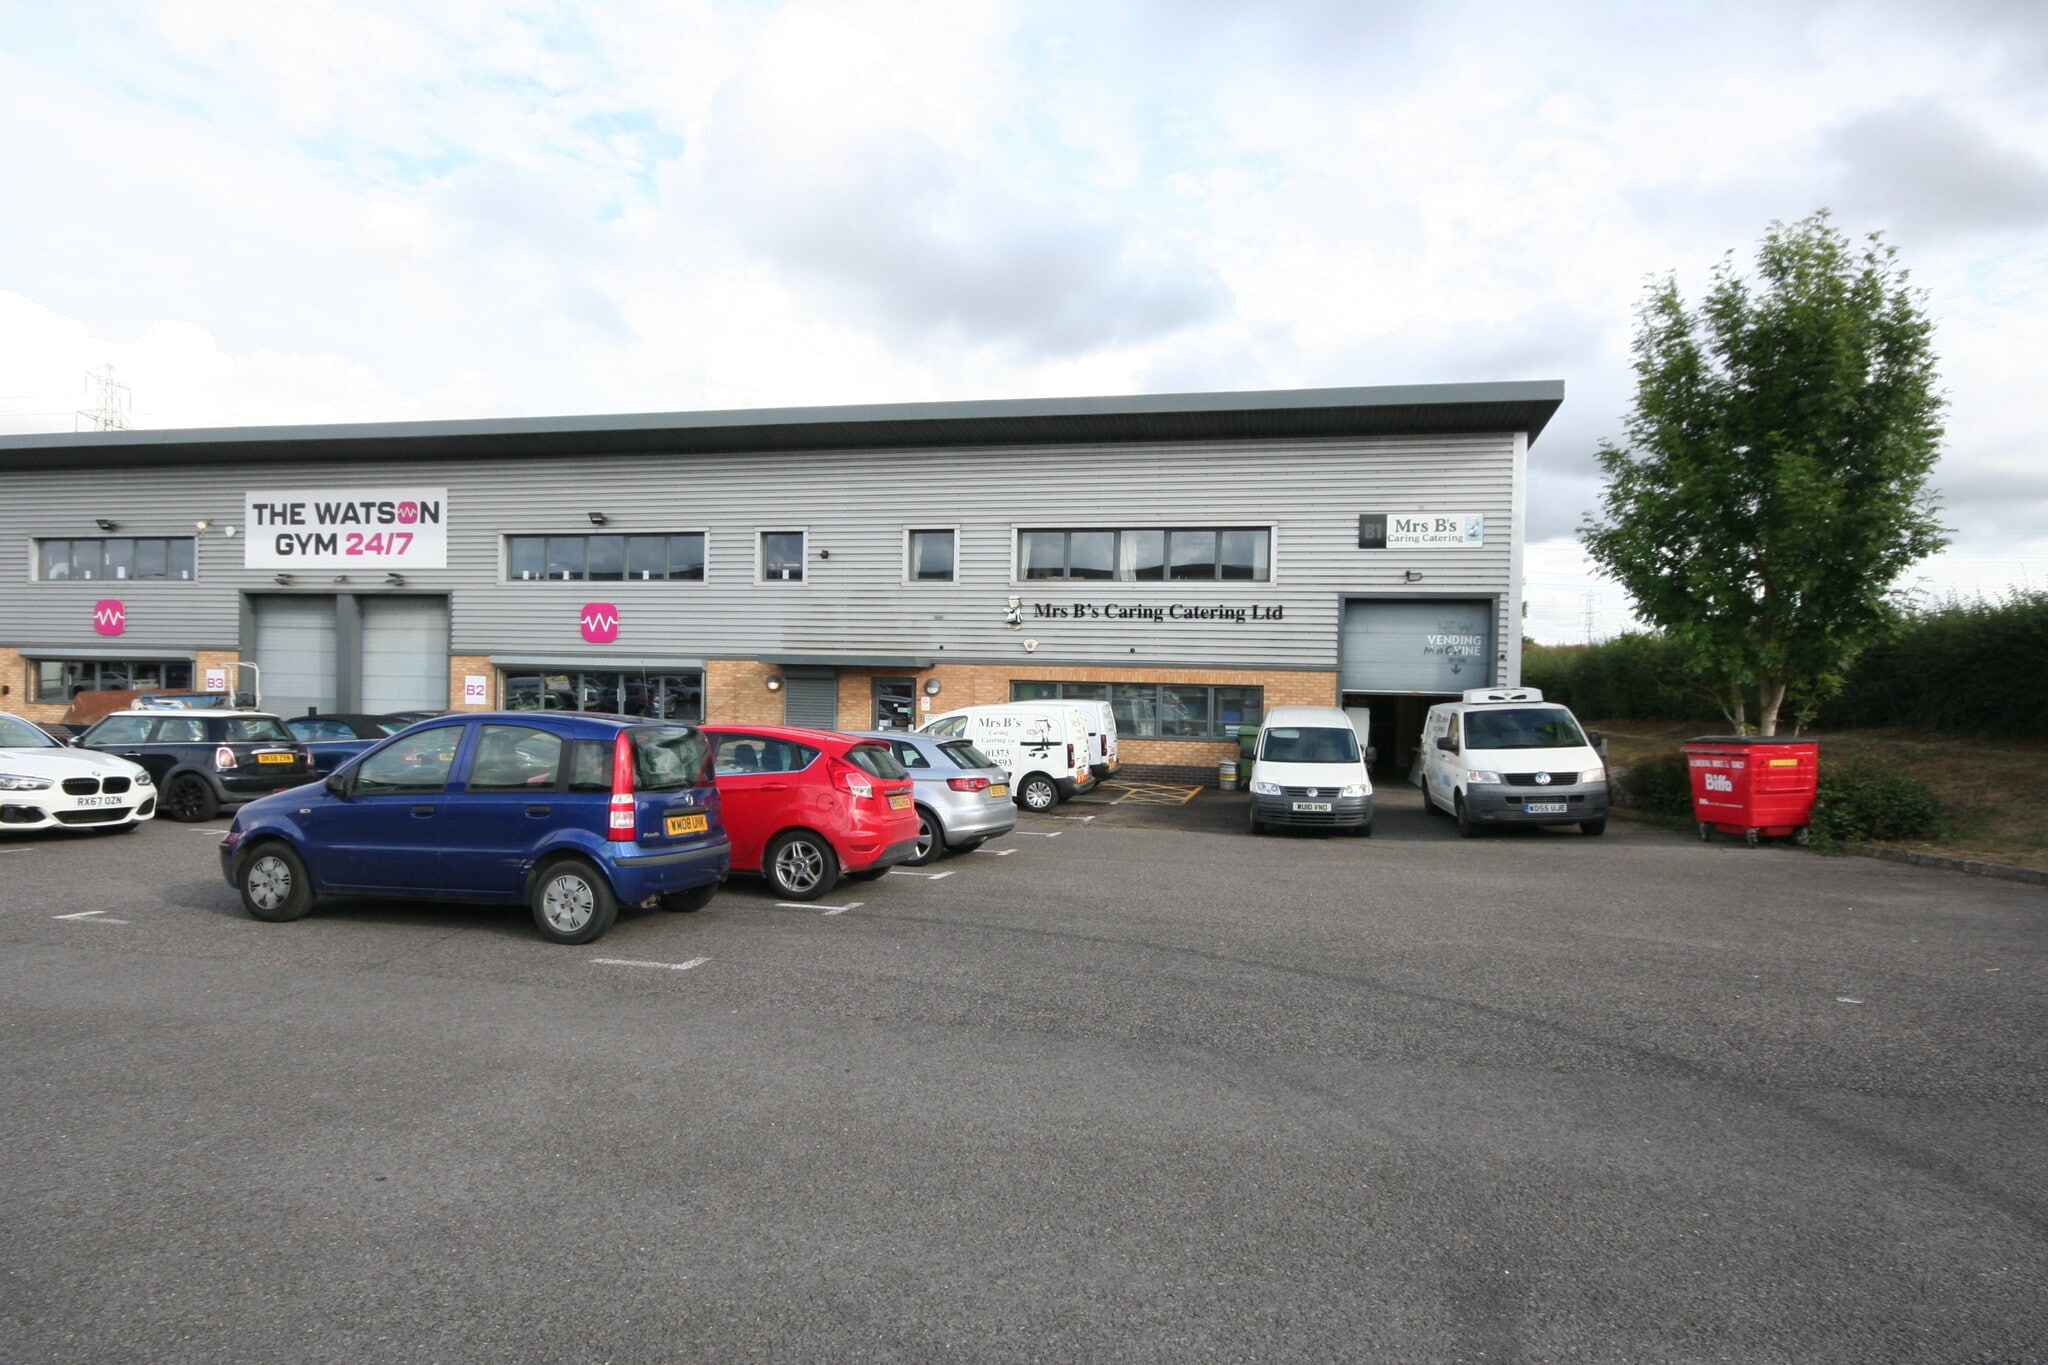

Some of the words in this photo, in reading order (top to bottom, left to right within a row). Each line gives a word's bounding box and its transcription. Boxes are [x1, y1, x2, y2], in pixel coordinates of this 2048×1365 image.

[252, 503, 306, 525] THE
[314, 500, 440, 525] WATSON
[1364, 523, 1383, 539] B1
[1395, 519, 1429, 533] Mrs
[1434, 518, 1457, 533] B's
[275, 533, 337, 556] GYM
[345, 532, 414, 556] 24/7
[1387, 535, 1420, 543] Caring
[1422, 533, 1464, 543] Catering
[1033, 603, 1068, 618] Mrs
[1073, 603, 1099, 618] B's
[1104, 603, 1163, 622] Caring
[1168, 604, 1246, 623] Catering
[1251, 605, 1283, 620] Ltd
[1427, 635, 1482, 646] VENDING
[207, 677, 224, 689] B3
[466, 684, 485, 696] B2
[978, 717, 1001, 728] Mrs
[985, 749, 1010, 757] 01373
[1705, 773, 1733, 792] Biffa
[77, 797, 103, 806] RX67
